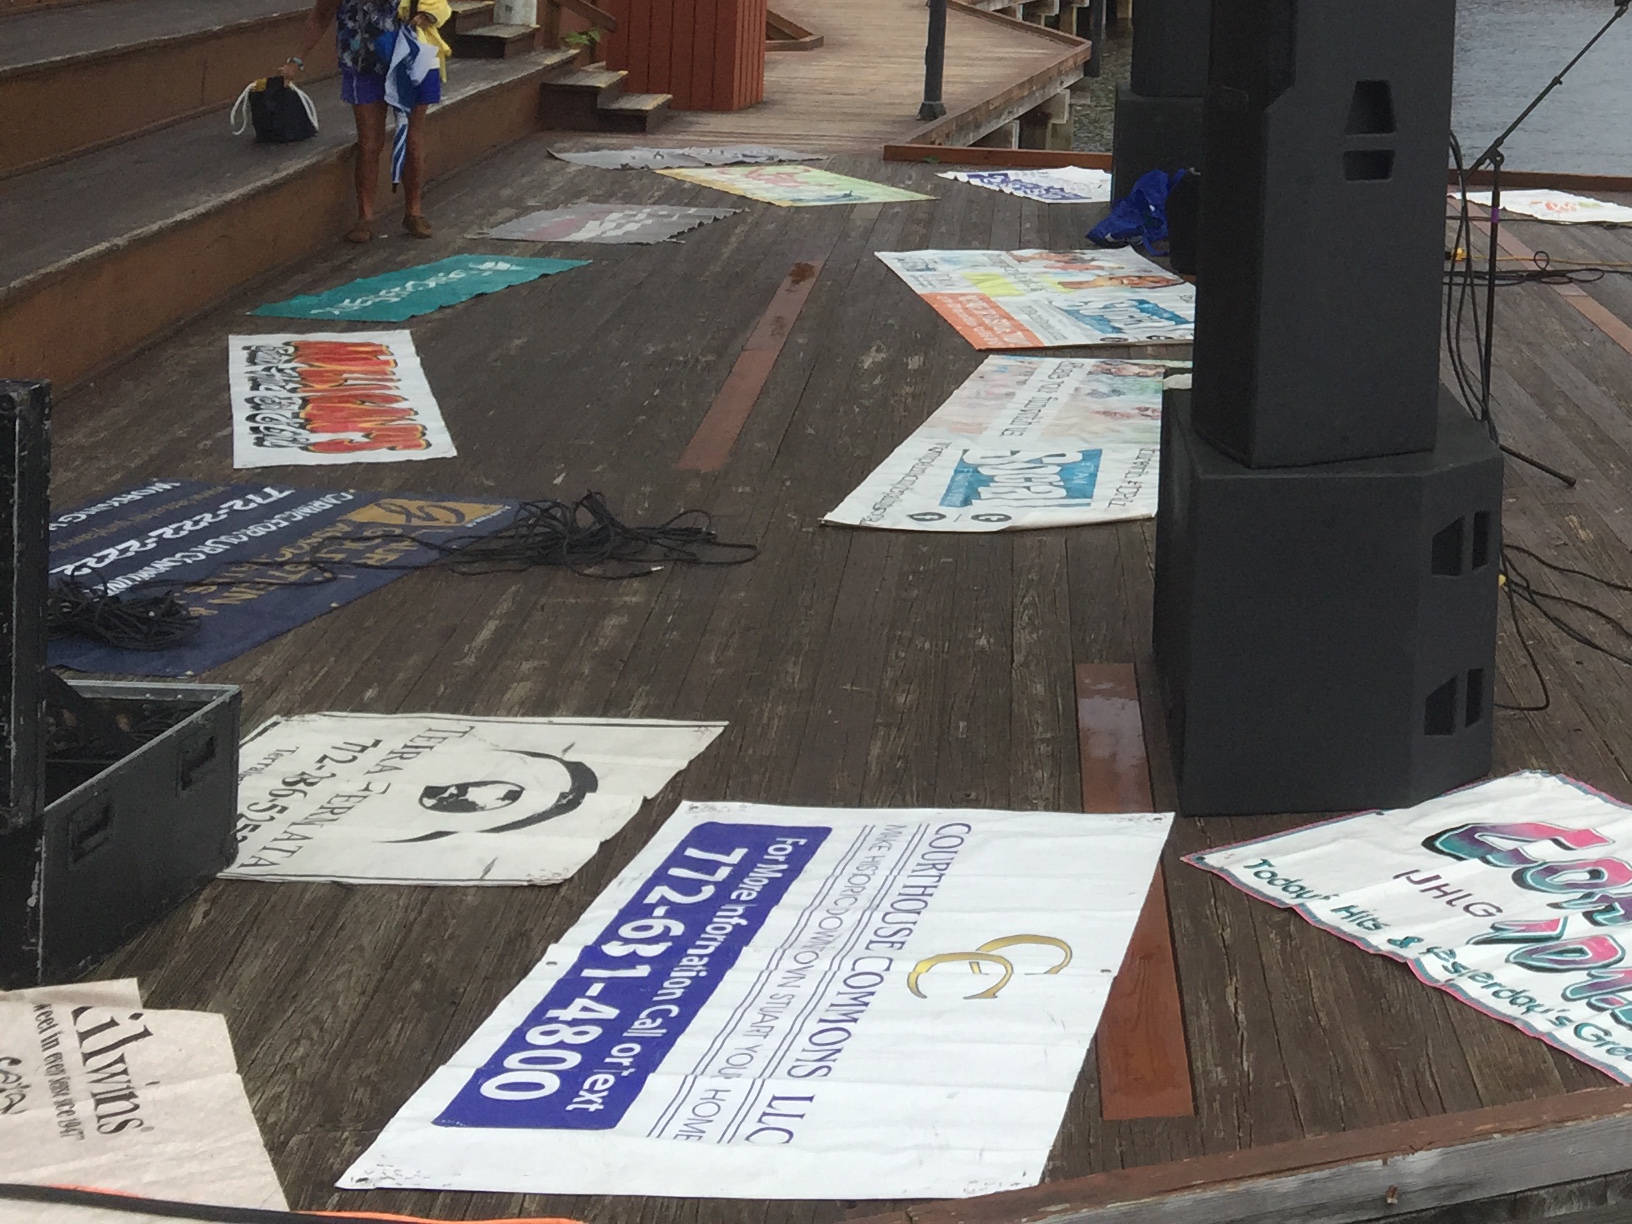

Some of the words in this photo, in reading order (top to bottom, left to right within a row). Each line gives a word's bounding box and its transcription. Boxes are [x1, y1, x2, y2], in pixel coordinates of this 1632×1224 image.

[961, 449, 1093, 508] Social
[766, 836, 808, 862] For
[730, 859, 782, 903] More
[863, 821, 973, 952] COURTHOUSE
[1330, 902, 1391, 933] Hits
[1386, 935, 1425, 950] &
[479, 846, 749, 1101] 772-631-4800
[621, 1003, 680, 1038] Call
[786, 955, 895, 1078] COMMONS
[604, 1041, 642, 1069] or
[672, 1088, 732, 1143] HOME
[743, 1092, 816, 1145] LLC
